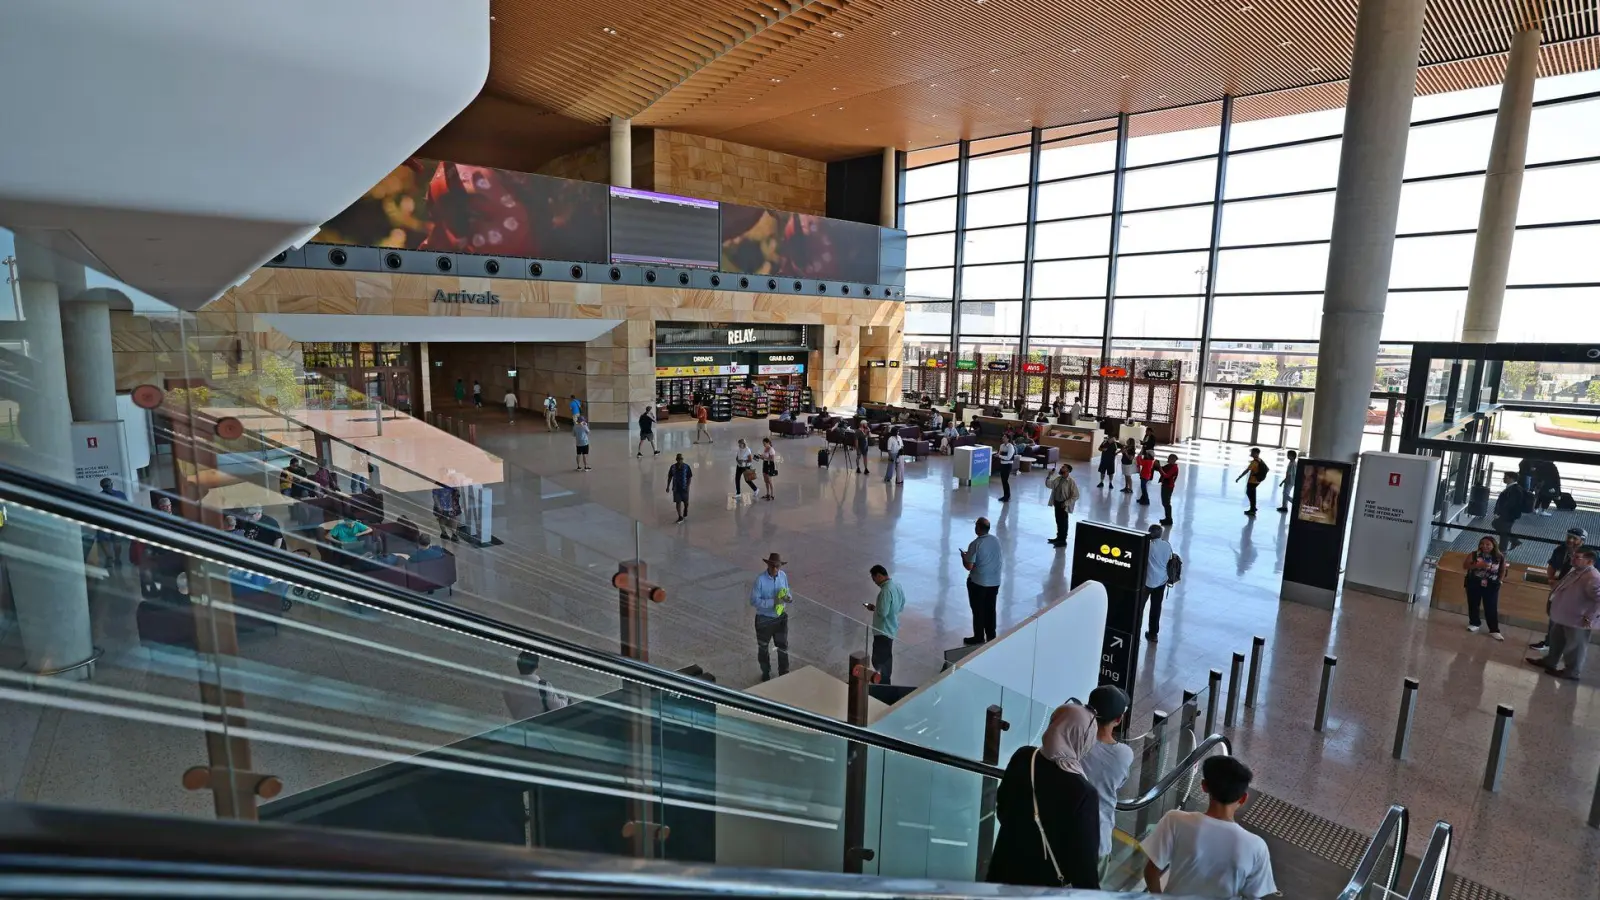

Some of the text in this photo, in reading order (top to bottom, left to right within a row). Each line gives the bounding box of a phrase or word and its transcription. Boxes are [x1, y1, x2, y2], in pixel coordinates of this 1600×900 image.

[432, 288, 500, 304] Arrivals
[728, 328, 754, 345] RELAY
[1096, 554, 1131, 568] Departures
[1102, 653, 1114, 664] al
[1101, 665, 1120, 682] ing
